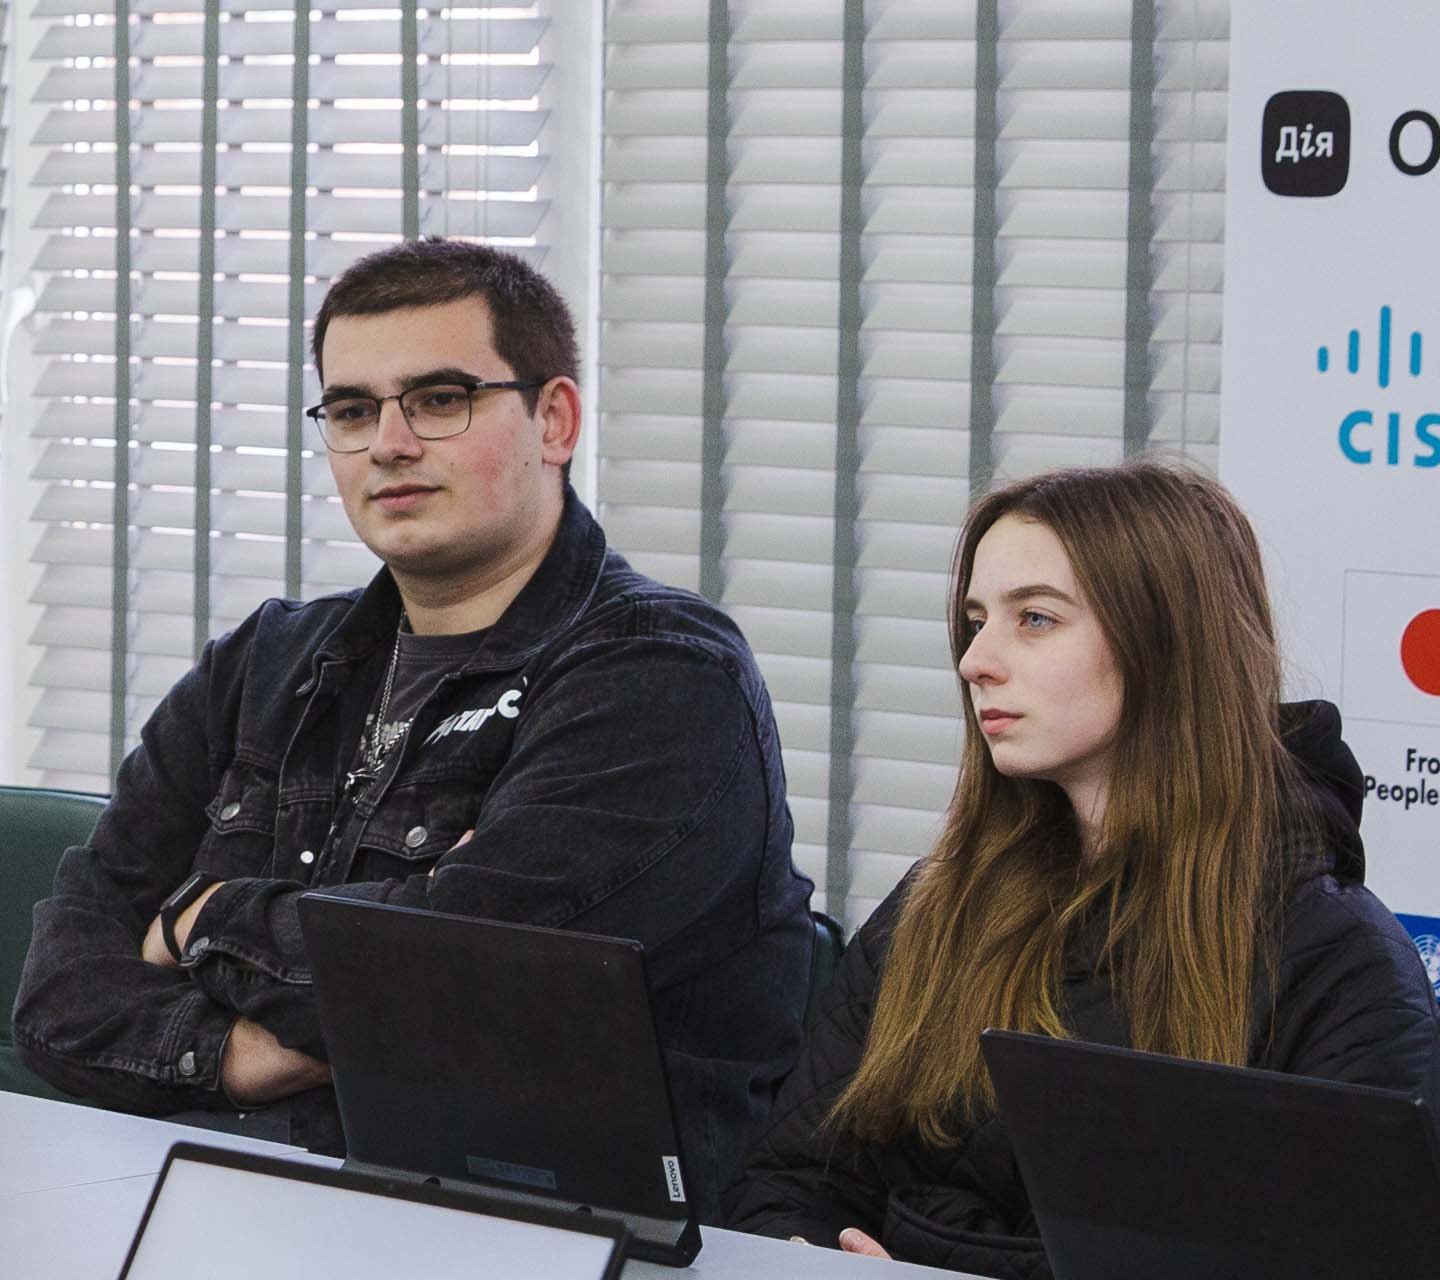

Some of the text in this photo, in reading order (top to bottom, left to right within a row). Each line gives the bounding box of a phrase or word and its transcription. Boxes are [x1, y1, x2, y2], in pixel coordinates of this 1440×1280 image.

[1276, 125, 1334, 162] Дія
[1363, 776, 1439, 810] People
[667, 1160, 681, 1198] Lenovo
